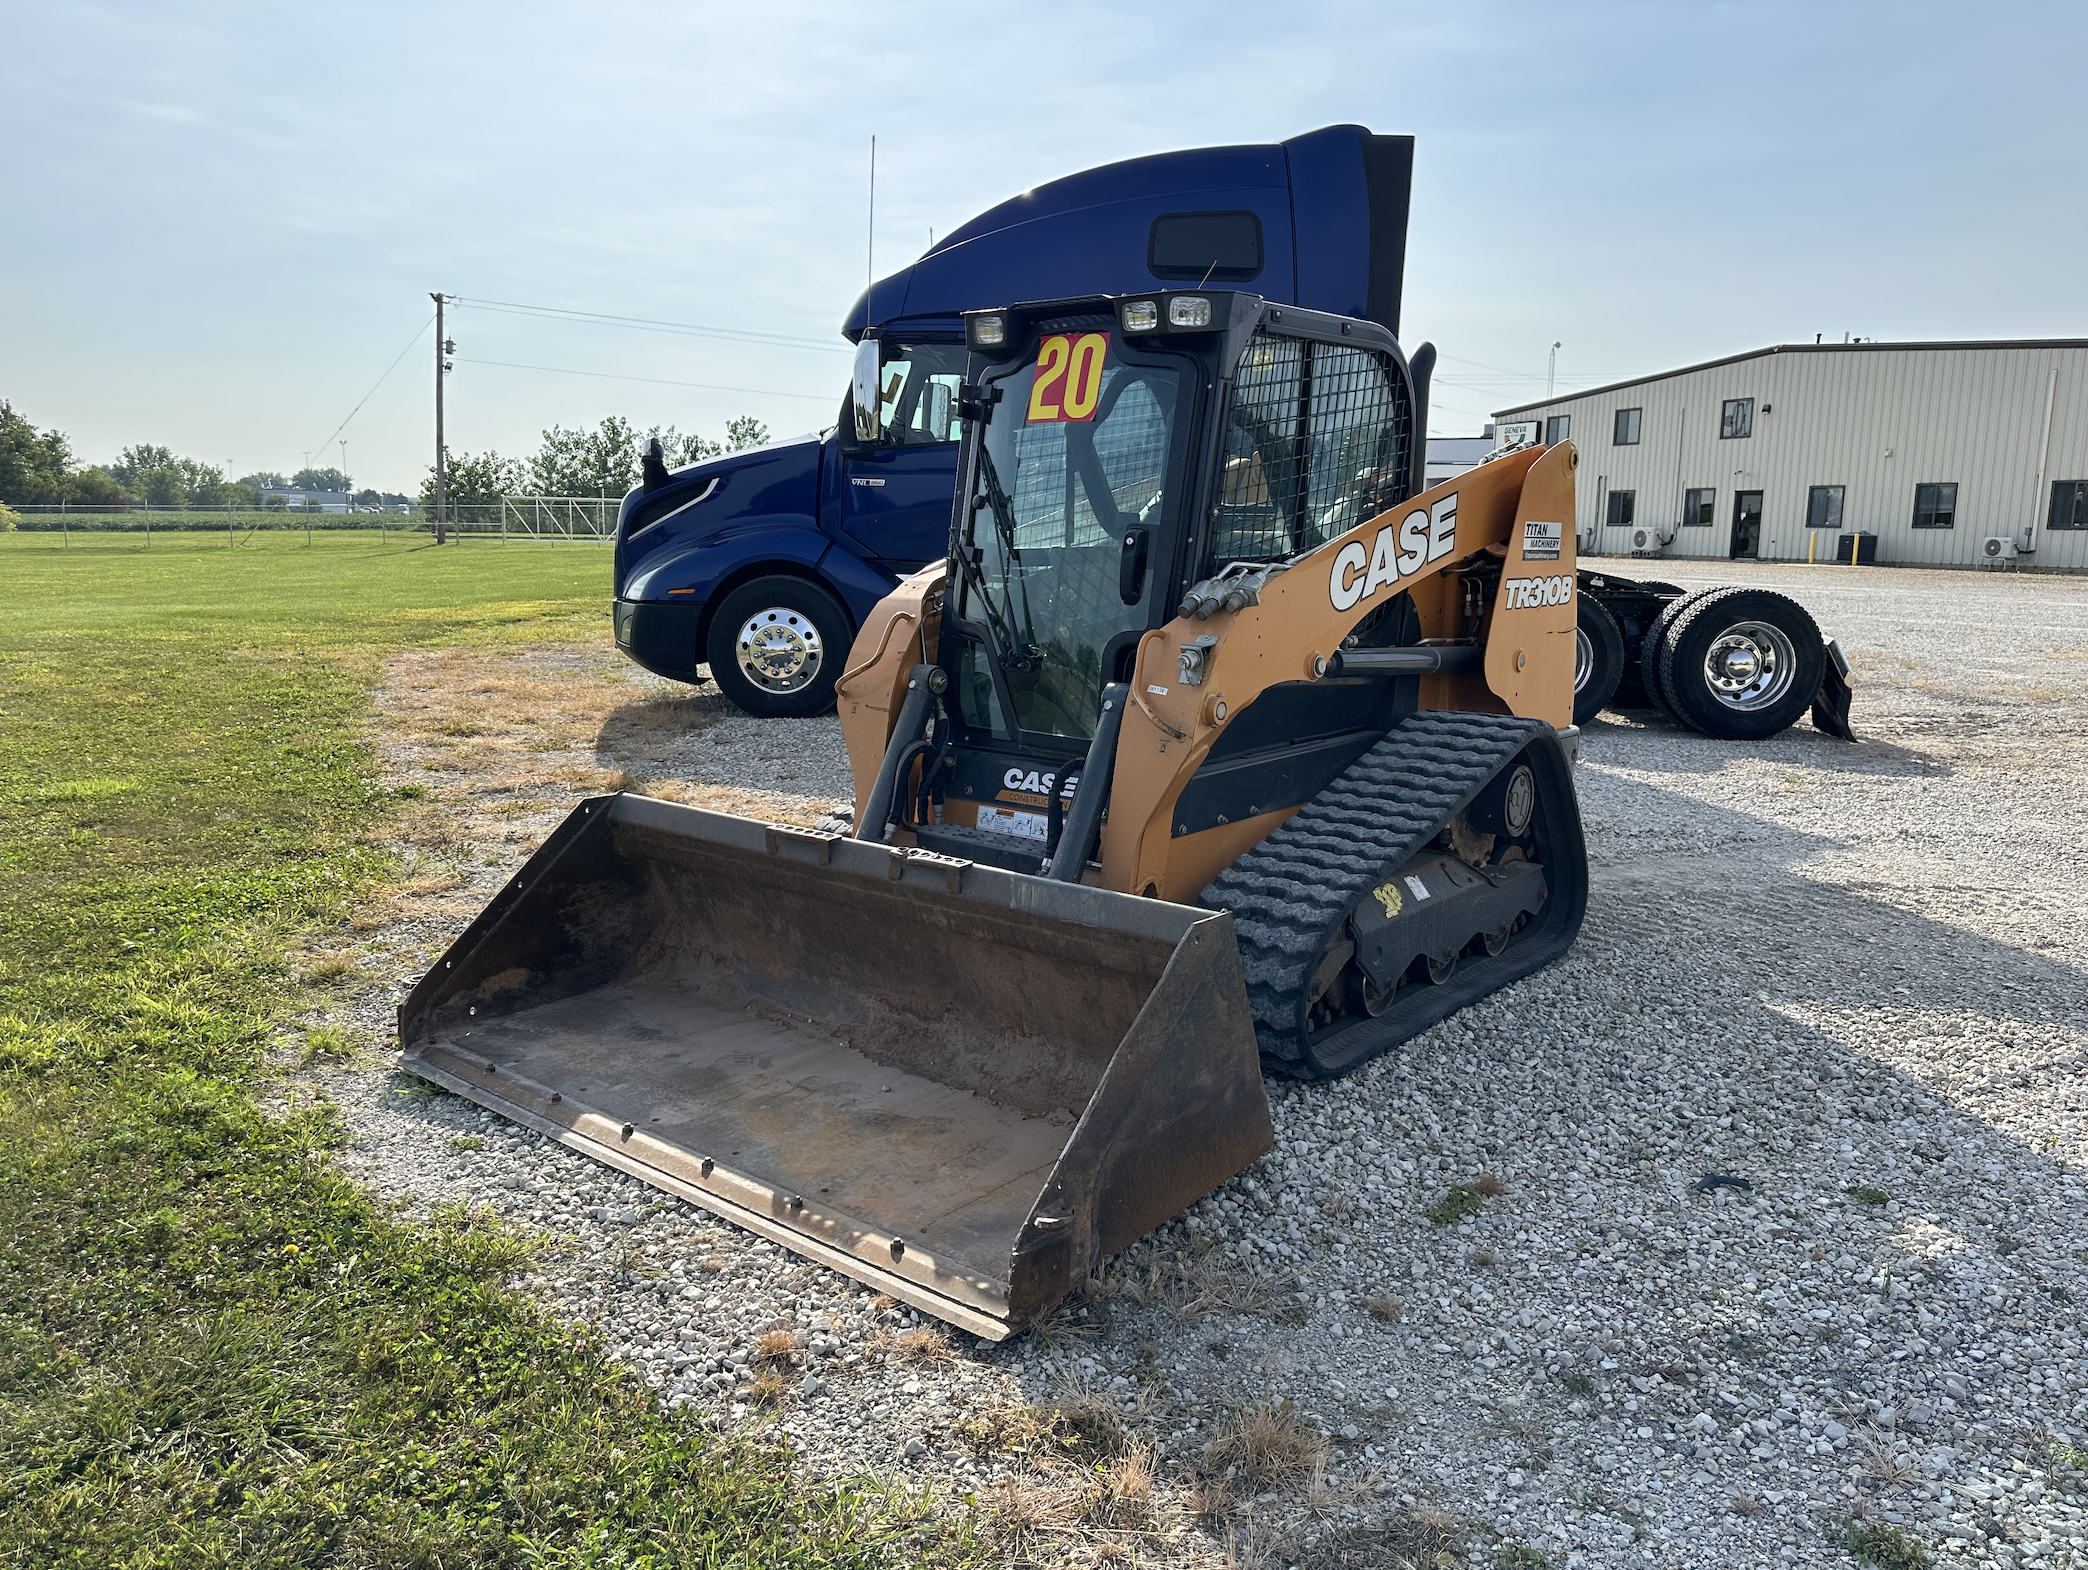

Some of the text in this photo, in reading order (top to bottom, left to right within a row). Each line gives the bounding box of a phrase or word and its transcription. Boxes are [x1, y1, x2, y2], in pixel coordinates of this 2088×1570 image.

[1028, 333, 1106, 420] 20
[1504, 426, 1527, 434] GENEVA
[1526, 523, 1549, 536] TITAN
[1329, 491, 1458, 613] CASE
[1530, 540, 1560, 548] MACHINERY
[1505, 575, 1573, 610] TR310B
[1003, 767, 1079, 798] CASE
[1008, 792, 1068, 809] CONSTRUCN
